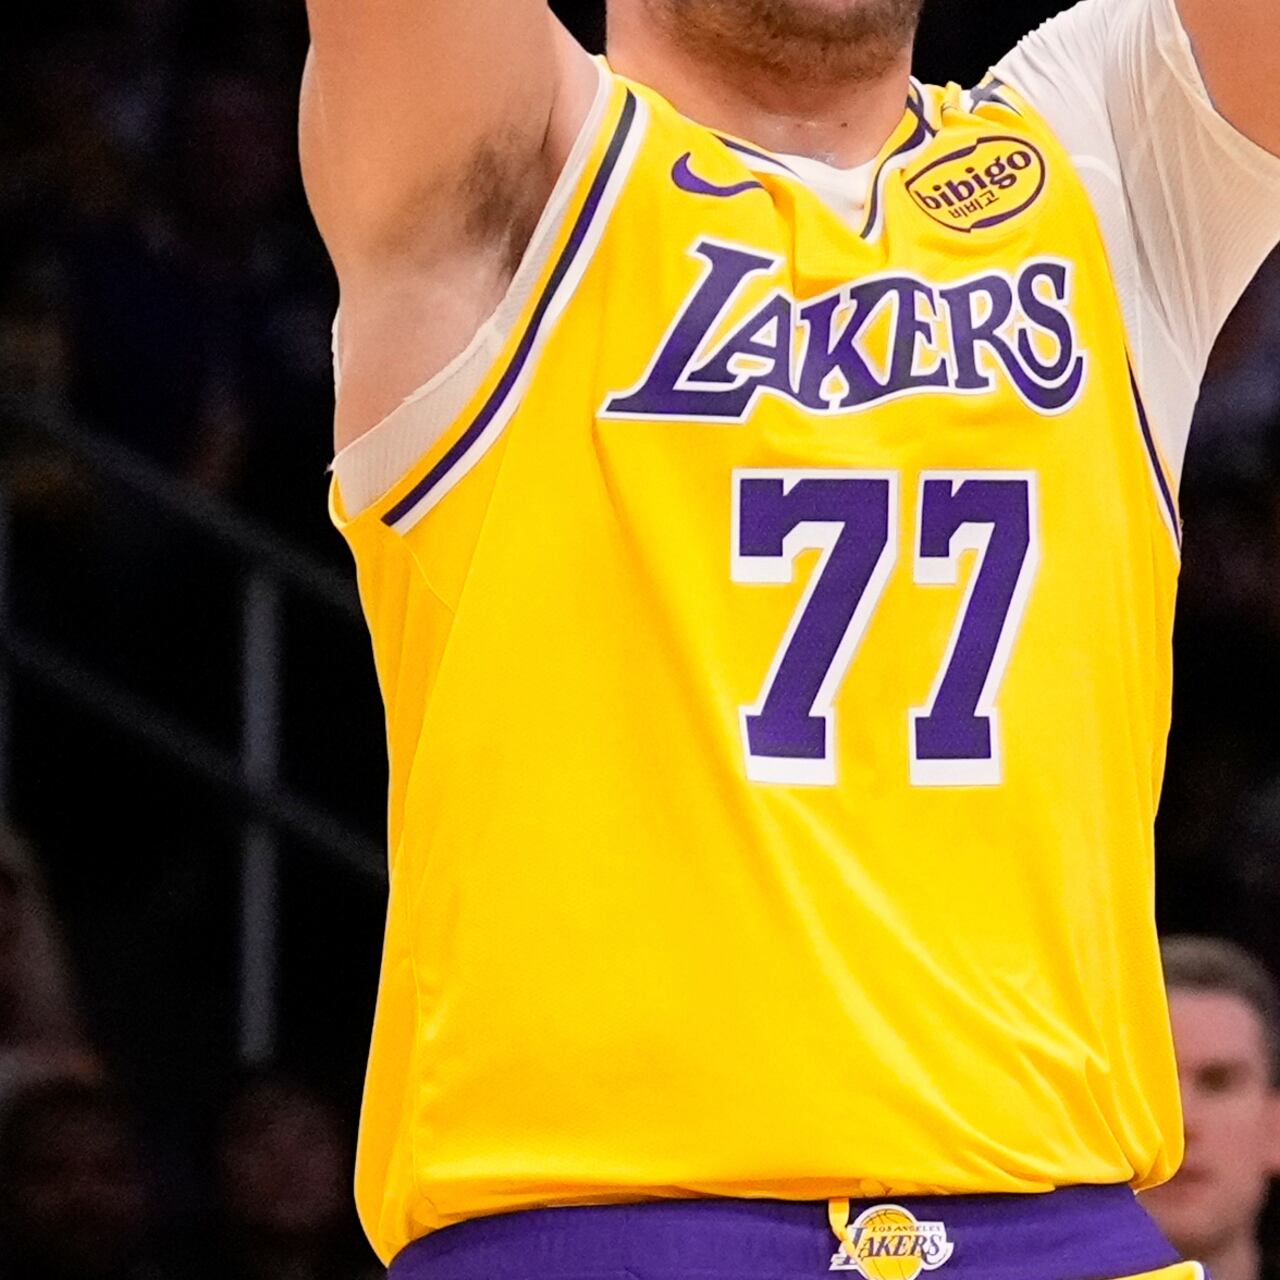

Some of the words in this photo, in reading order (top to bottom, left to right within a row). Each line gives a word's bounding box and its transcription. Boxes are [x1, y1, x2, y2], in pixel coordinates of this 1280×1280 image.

[914, 150, 1032, 210] bibigo
[597, 237, 1087, 423] LAKERS
[730, 468, 1040, 785] 77
